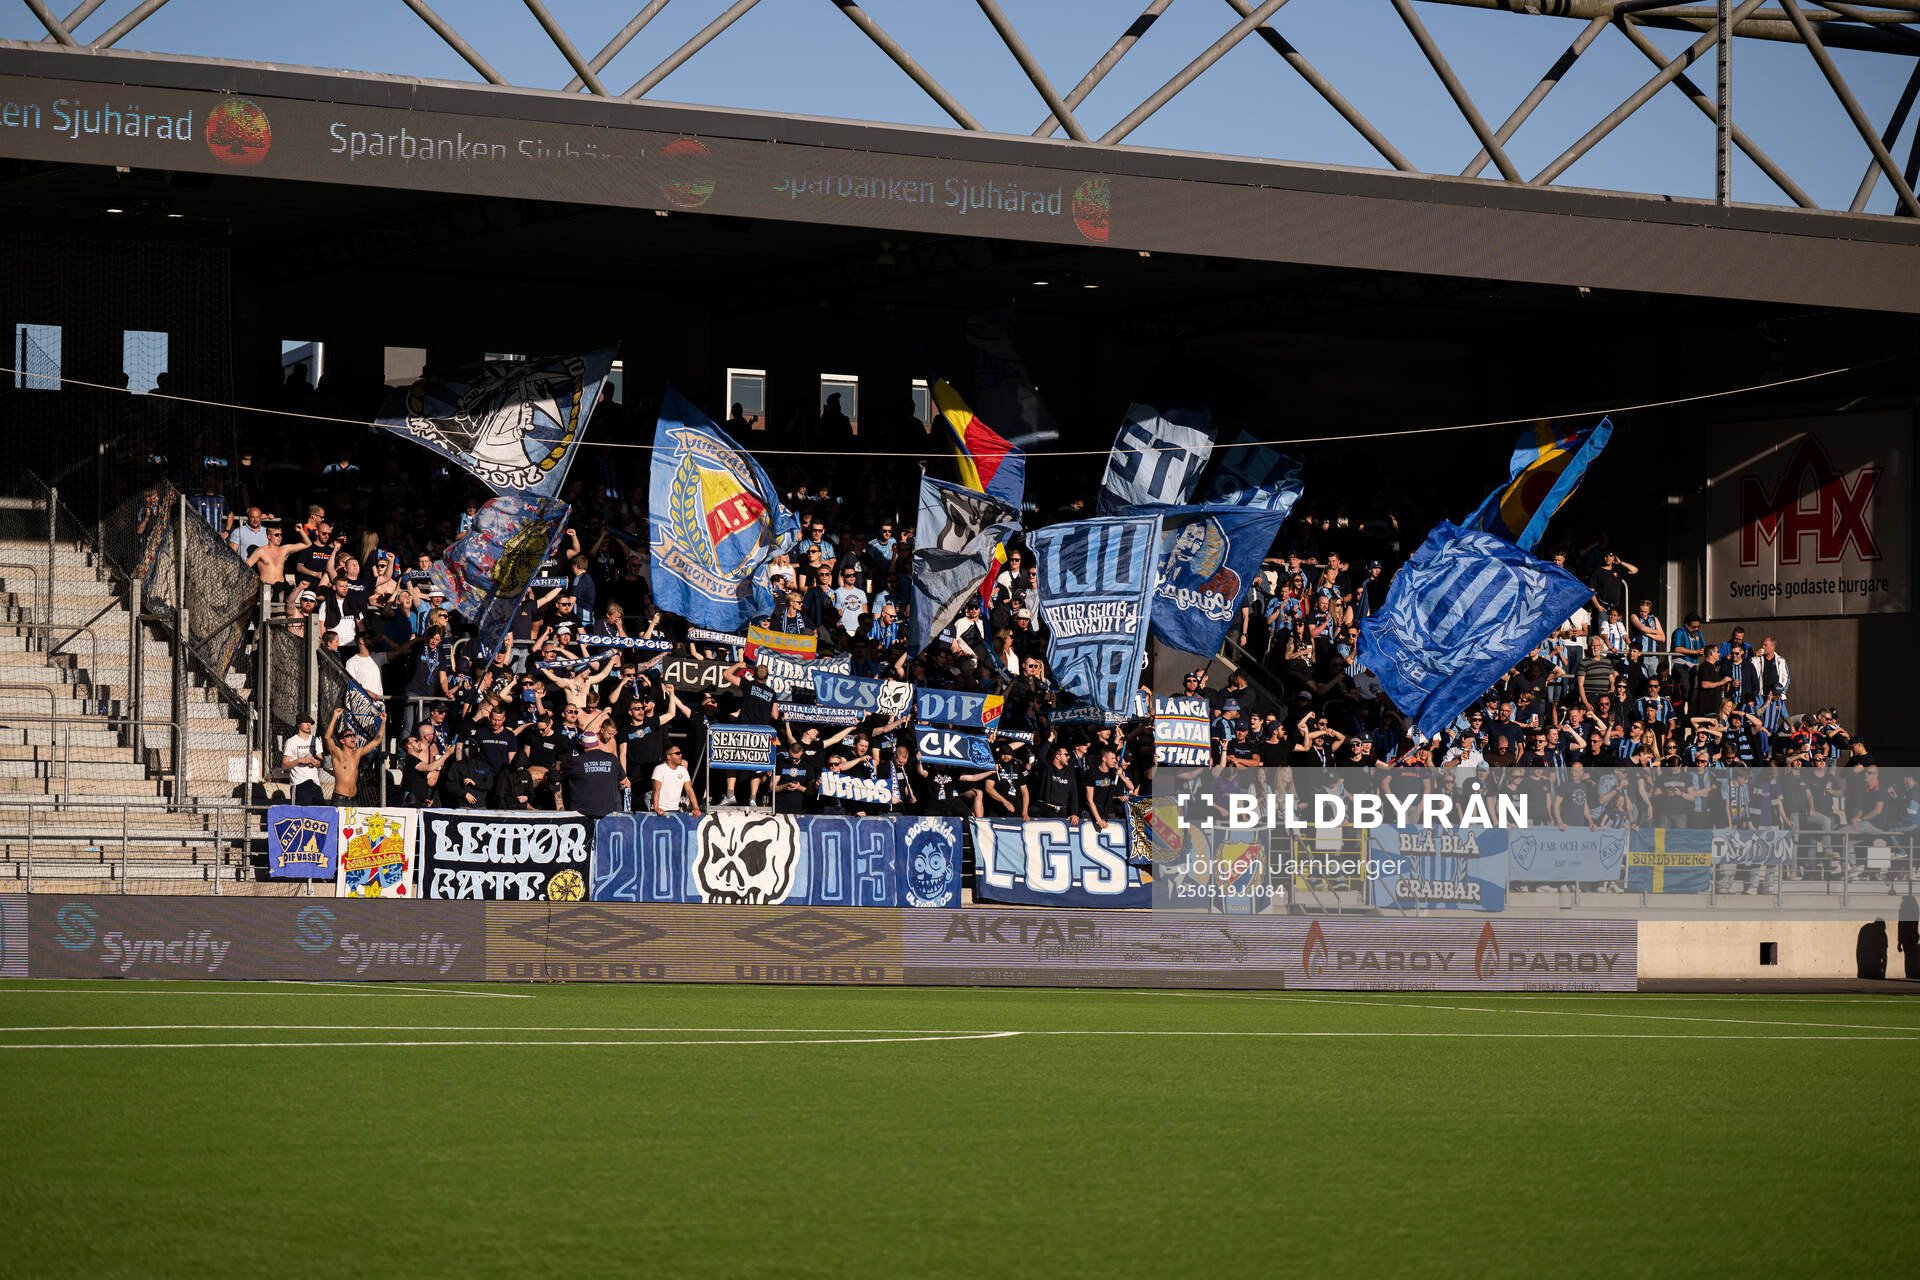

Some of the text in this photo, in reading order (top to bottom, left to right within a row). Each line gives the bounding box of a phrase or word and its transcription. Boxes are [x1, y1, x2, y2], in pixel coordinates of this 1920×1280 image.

[0, 98, 192, 140] en Sjuhärad
[329, 121, 506, 162] Sparbanken
[943, 177, 1062, 215] Sjuhärad
[1739, 432, 1884, 568] MAX
[1730, 575, 1889, 601] Sveriges godaste burgare
[581, 633, 621, 645] 2003
[813, 674, 878, 708] UCS
[919, 693, 985, 721] DIF
[1156, 697, 1209, 718] LÅNGA
[712, 732, 771, 749] SEKTION
[919, 733, 964, 759] CK
[1156, 746, 1211, 766] STHLM
[821, 771, 892, 801] ULTRAS
[431, 819, 588, 864] LEMON
[1400, 830, 1480, 855] BLÅ BLÅ
[1540, 840, 1598, 852] FAR OCH SON
[284, 852, 295, 863] DIF
[975, 820, 1128, 895] LGS
[1632, 853, 1706, 866] SUNDBYBERG
[1395, 878, 1481, 901] GRABBAR
[101, 929, 232, 973] Syncify
[338, 932, 463, 974] Syncify
[1336, 951, 1456, 971] PAROY
[1508, 952, 1620, 972] PAROY
[506, 963, 666, 980] UMBRO
[735, 965, 886, 982] UMBRO
